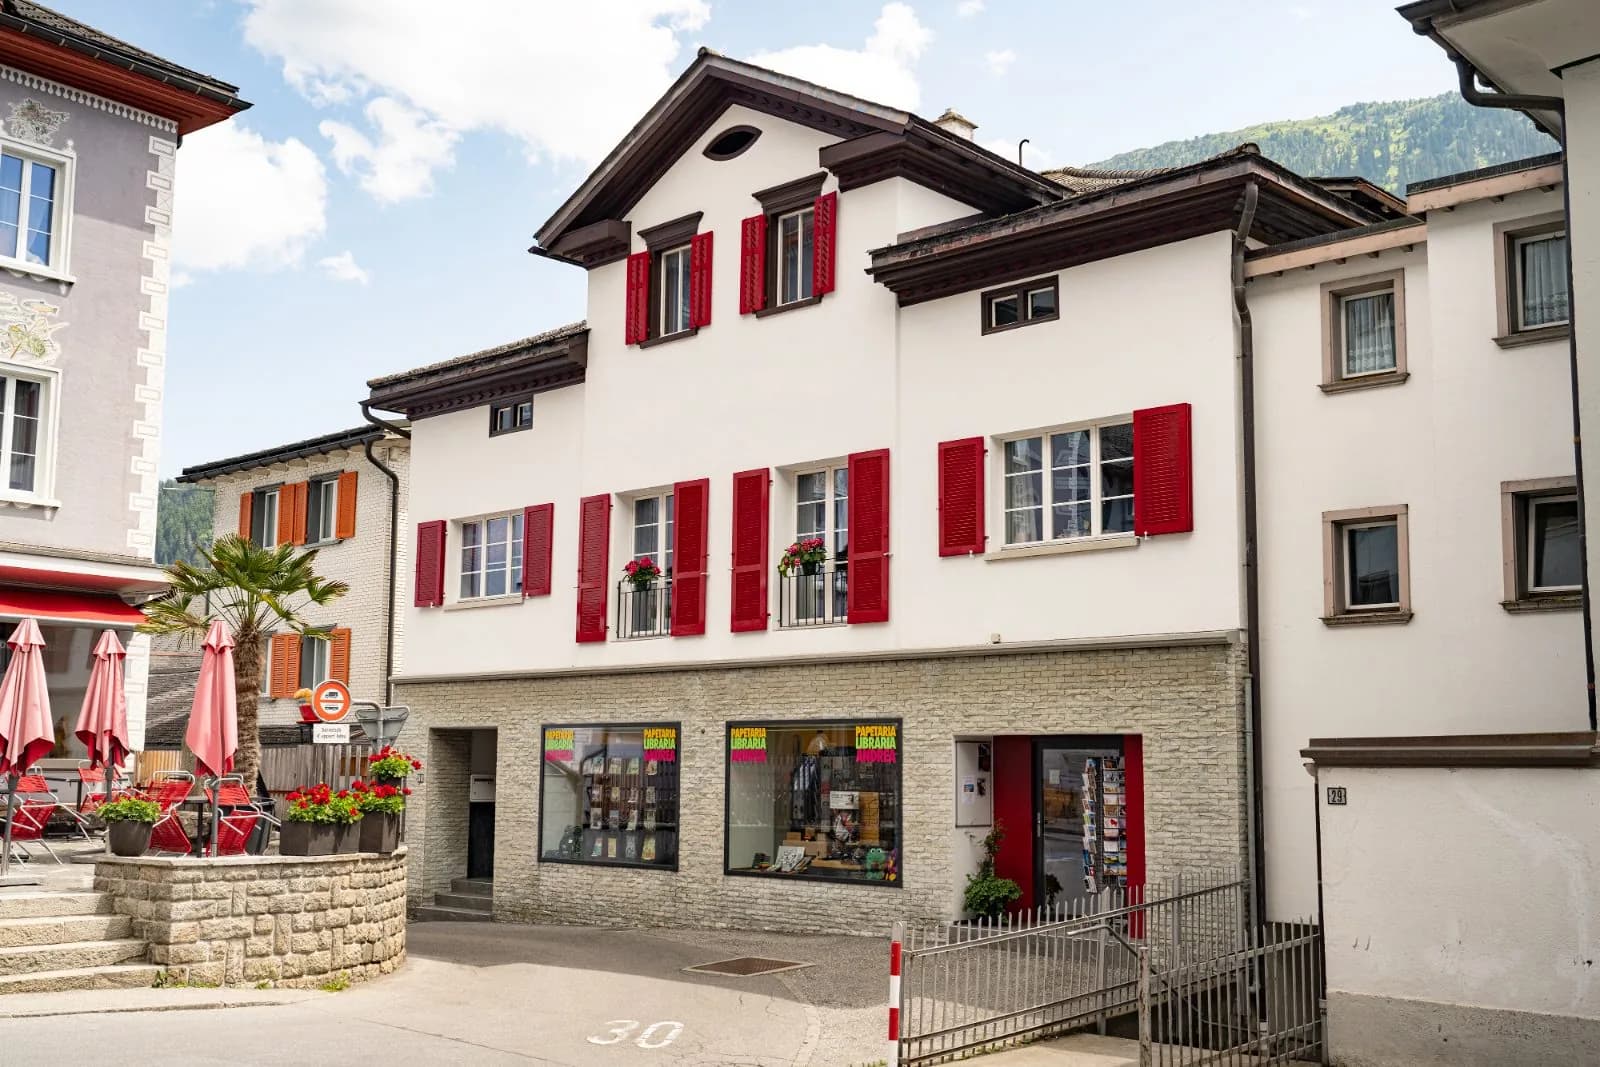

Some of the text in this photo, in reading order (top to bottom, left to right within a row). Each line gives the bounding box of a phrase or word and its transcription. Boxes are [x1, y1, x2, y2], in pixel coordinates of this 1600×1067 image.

[644, 728, 676, 738] PAPETARIA
[731, 727, 766, 738] PAPETARIA
[856, 725, 896, 737] PAPETARIA
[644, 738, 676, 749] LIBRARIA
[731, 737, 766, 749] LIBRARIA
[856, 736, 896, 749] LIBRARIA
[856, 749, 896, 763] ANDREA
[1331, 789, 1343, 803] 29
[586, 1019, 685, 1049] 30
